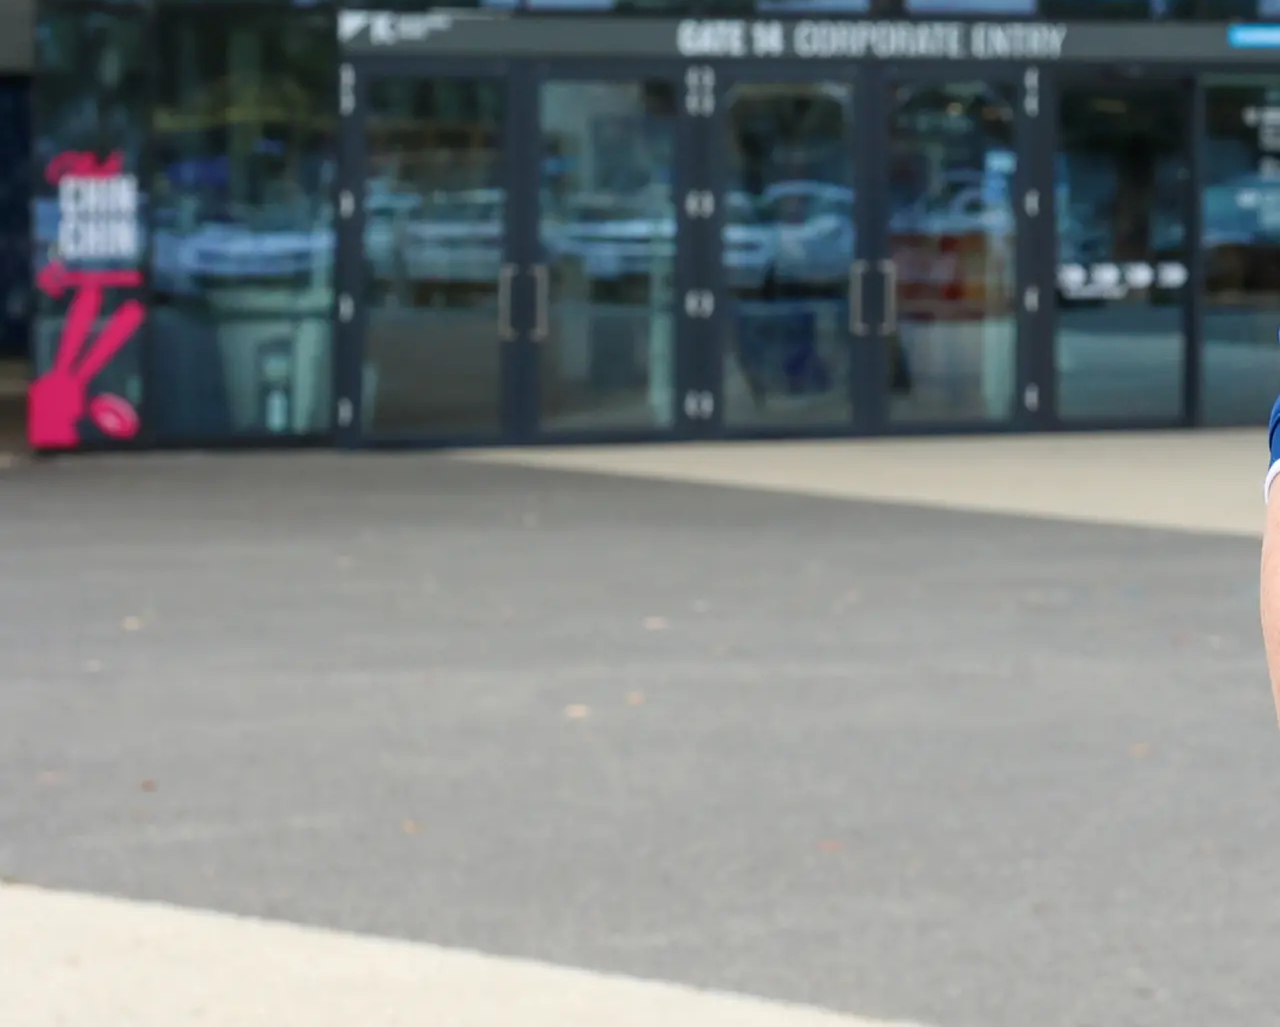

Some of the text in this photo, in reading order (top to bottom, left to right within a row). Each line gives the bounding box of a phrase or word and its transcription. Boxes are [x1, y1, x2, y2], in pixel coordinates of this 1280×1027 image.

[676, 18, 747, 57] GATE
[794, 19, 966, 59] CORPORATE
[970, 21, 1068, 60] ENTRY
